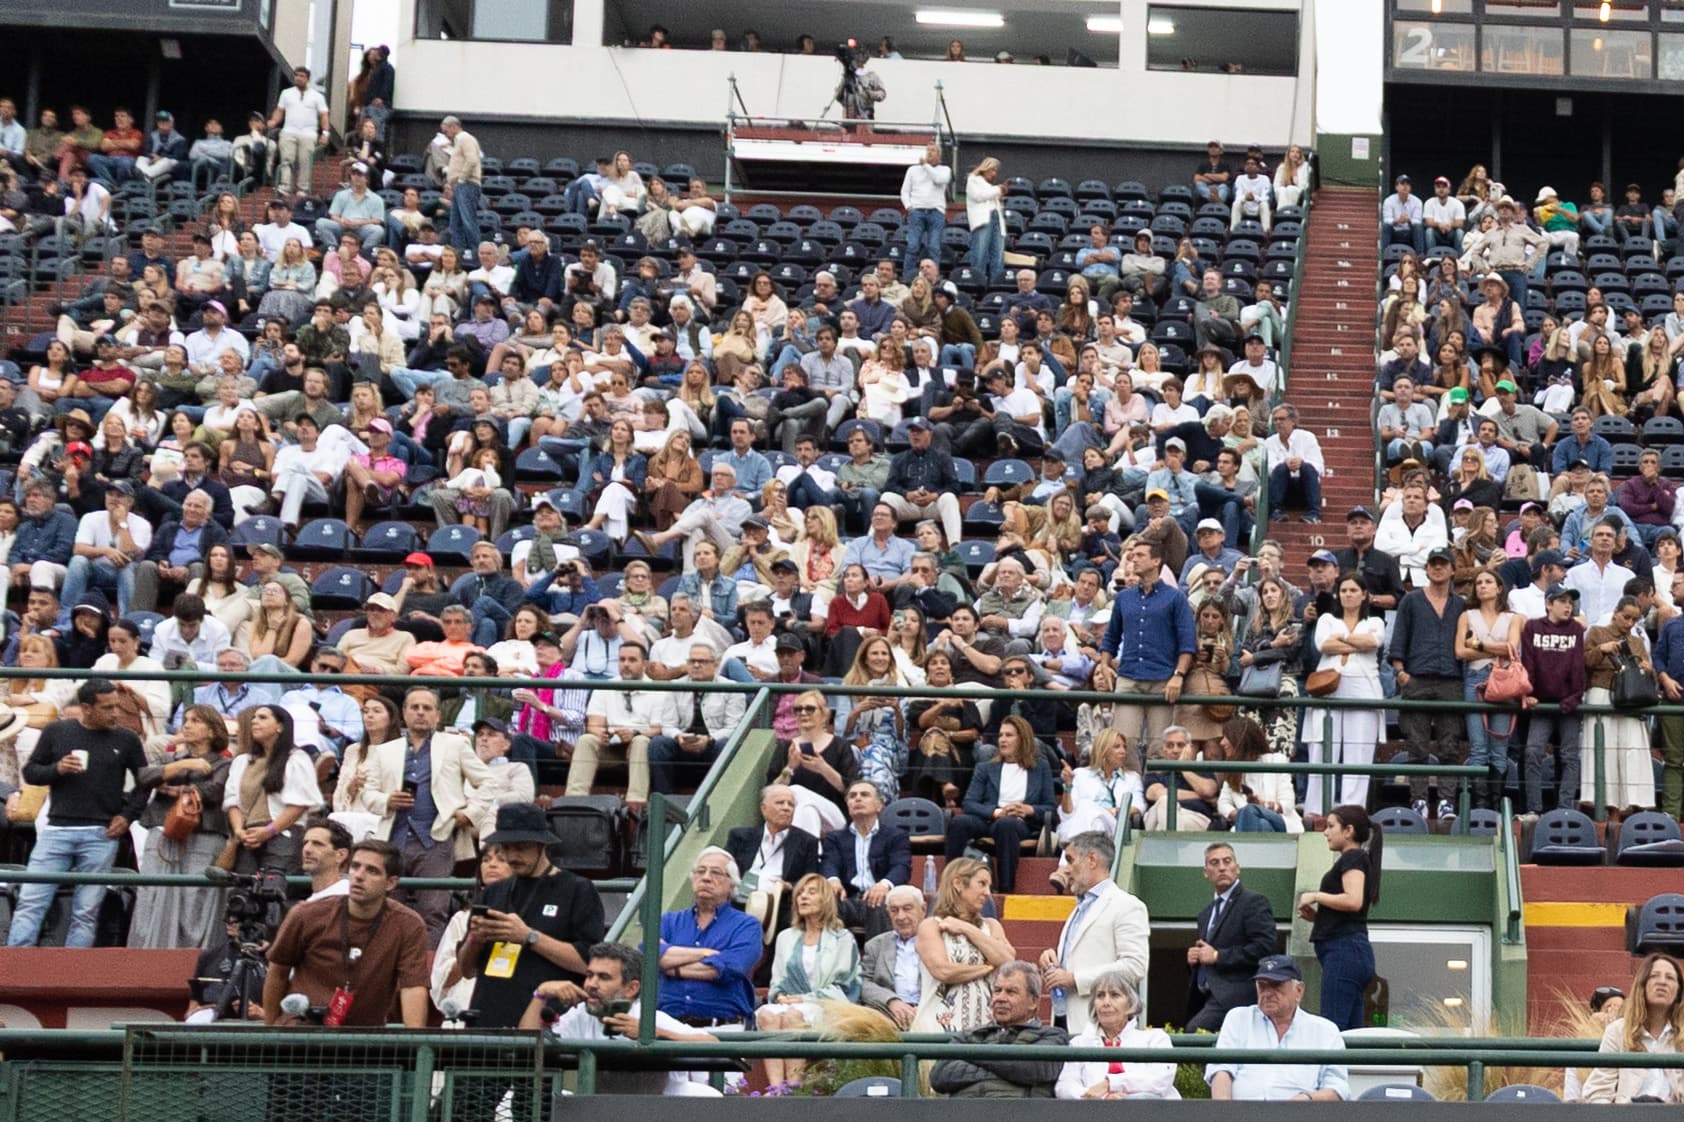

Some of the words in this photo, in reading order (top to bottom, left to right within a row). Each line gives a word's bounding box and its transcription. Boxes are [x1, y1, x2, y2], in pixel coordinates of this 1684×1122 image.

[1400, 28, 1433, 63] 2
[1309, 535, 1325, 547] 10
[1533, 633, 1577, 649] ASPEN
